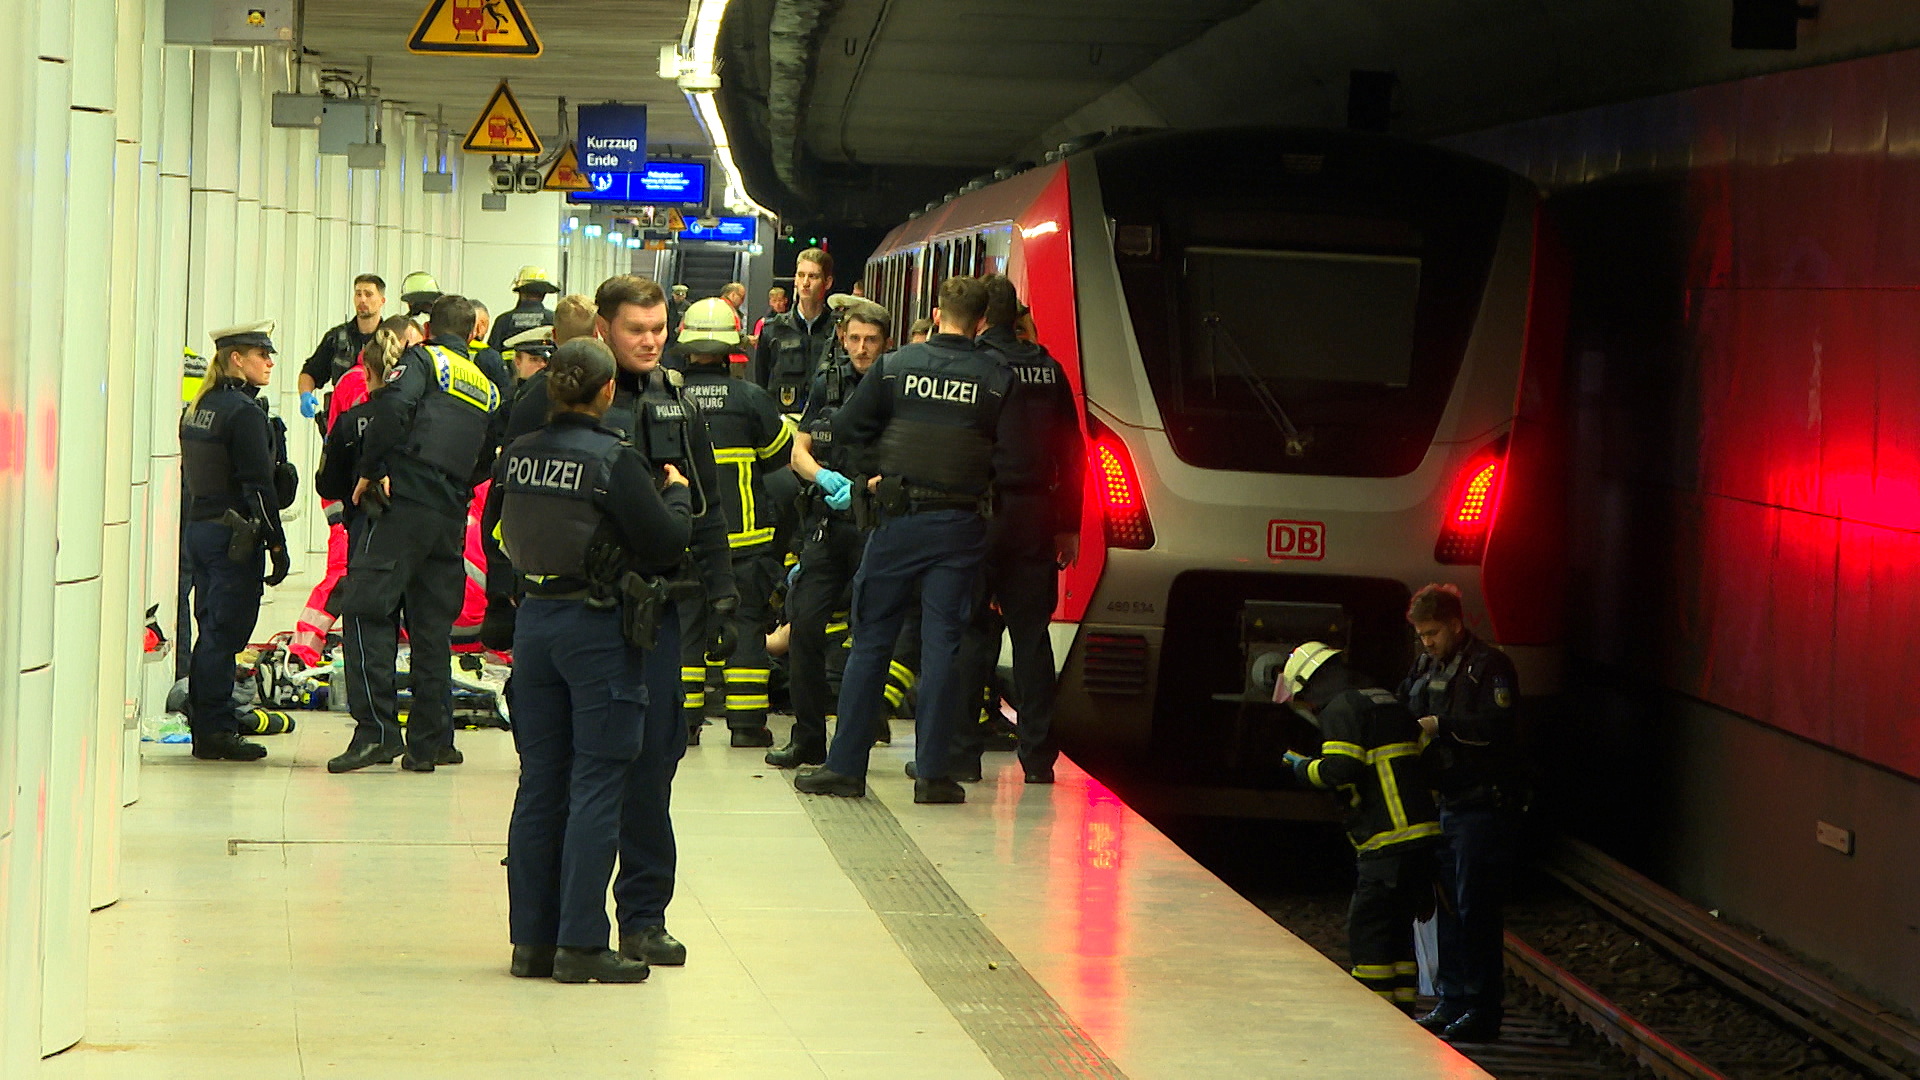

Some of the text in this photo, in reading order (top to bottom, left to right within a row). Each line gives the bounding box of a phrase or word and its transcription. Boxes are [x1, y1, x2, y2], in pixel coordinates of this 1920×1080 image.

[586, 135, 638, 152] Kurzzug
[586, 153, 619, 166] Ende
[1011, 366, 1056, 384] LIZEI
[687, 384, 729, 396] ERWEHR
[904, 374, 979, 404] POLIZEI
[697, 396, 724, 408] BURG
[506, 456, 584, 491] POLIZEI
[1274, 525, 1319, 554] DB
